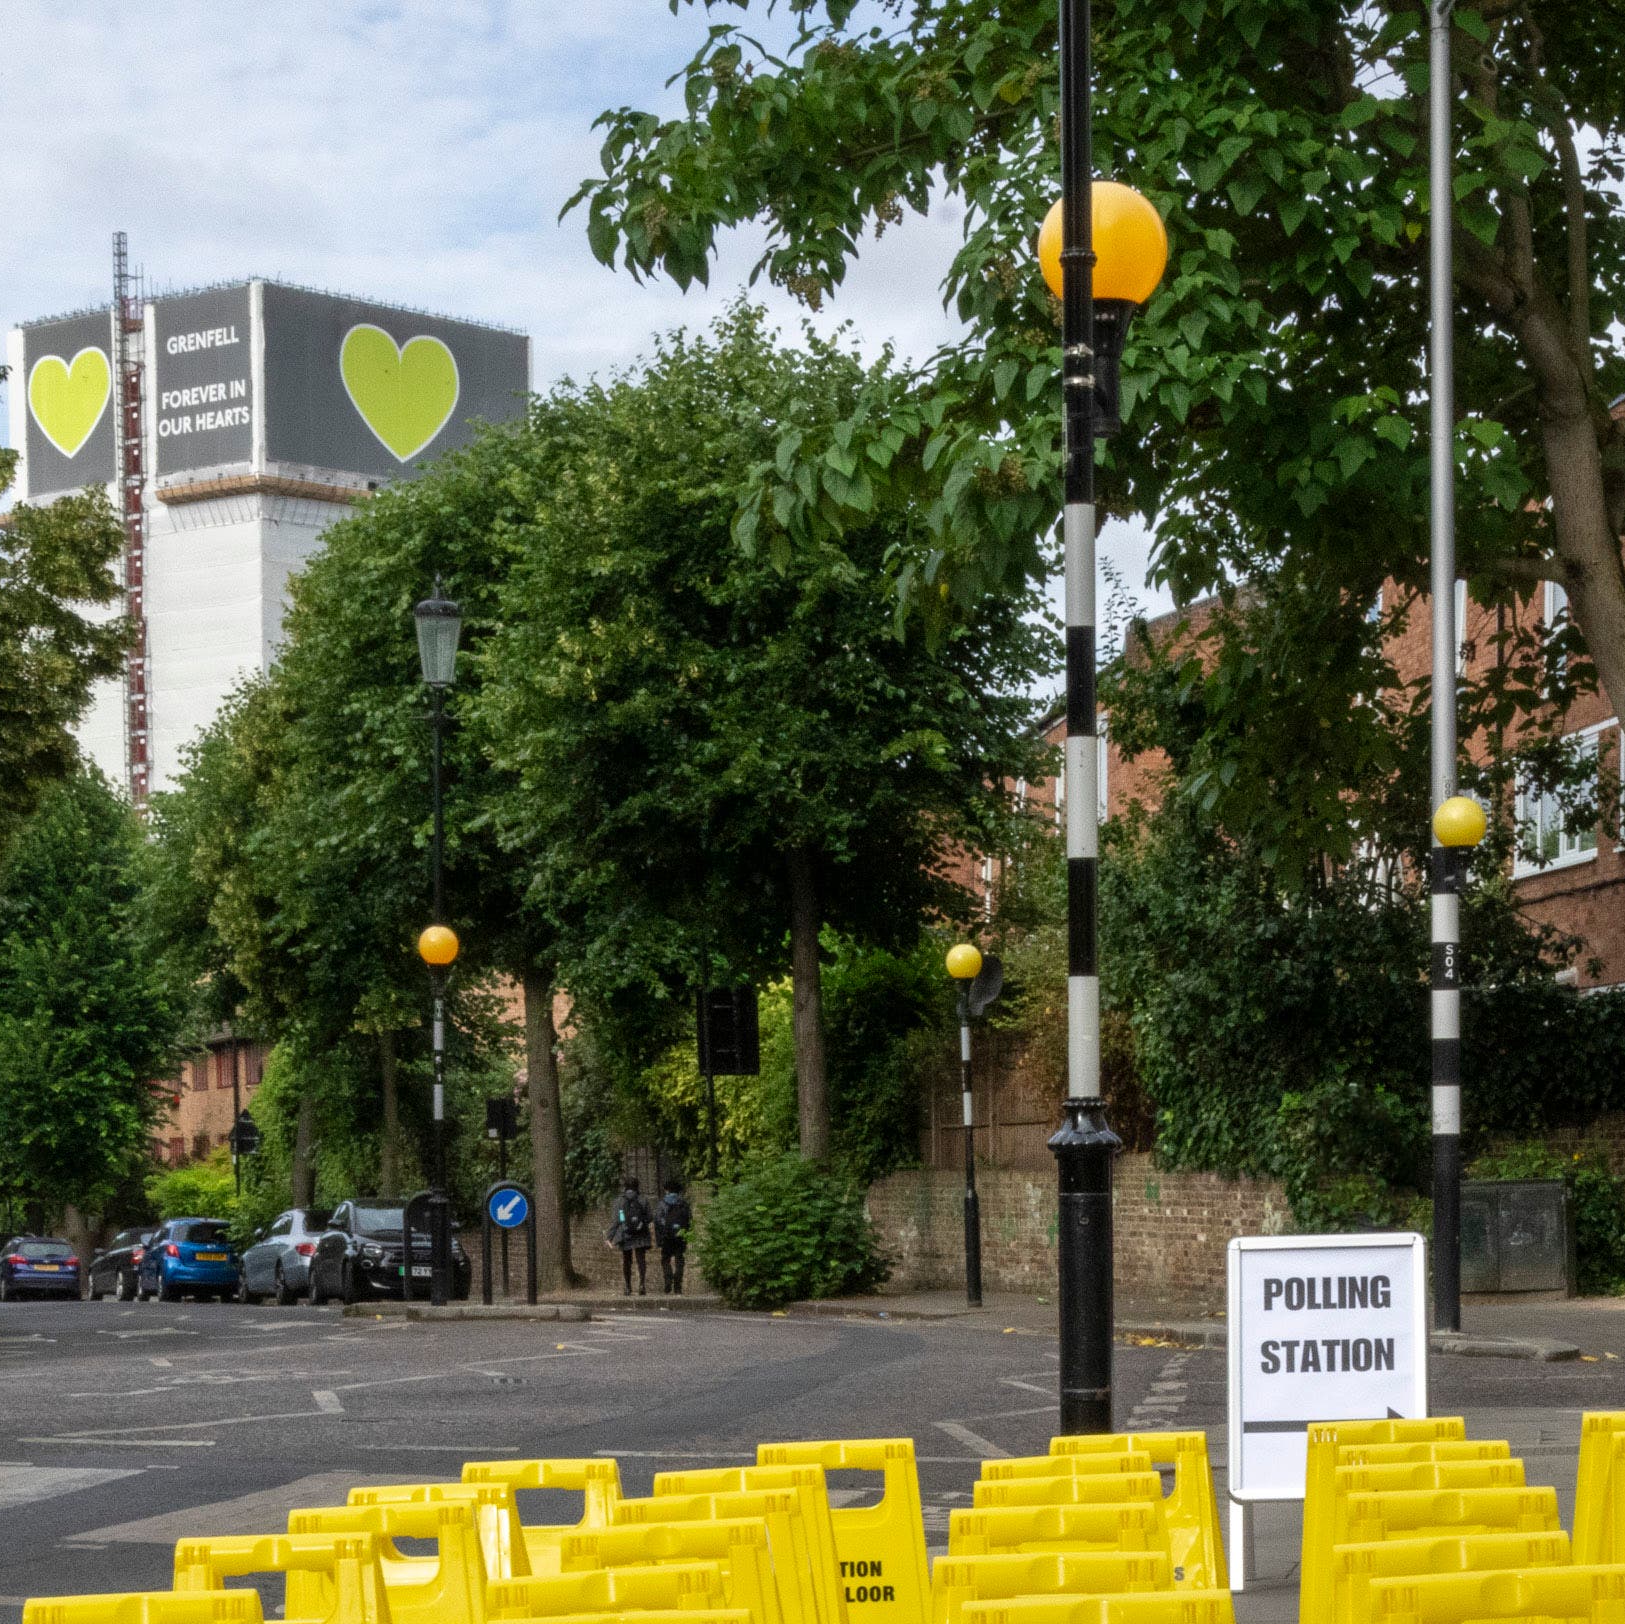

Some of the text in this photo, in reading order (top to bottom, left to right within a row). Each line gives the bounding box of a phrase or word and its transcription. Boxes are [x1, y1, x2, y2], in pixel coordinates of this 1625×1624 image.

[166, 325, 240, 355] GRENFELL
[161, 378, 246, 410] FOREVER IN
[158, 405, 250, 437] OUR HEARTS
[1444, 943, 1456, 980] S04
[1264, 1275, 1390, 1310] POLLING
[1261, 1338, 1394, 1373] STATION
[840, 1558, 884, 1580] TION
[844, 1584, 897, 1604] LOOR
